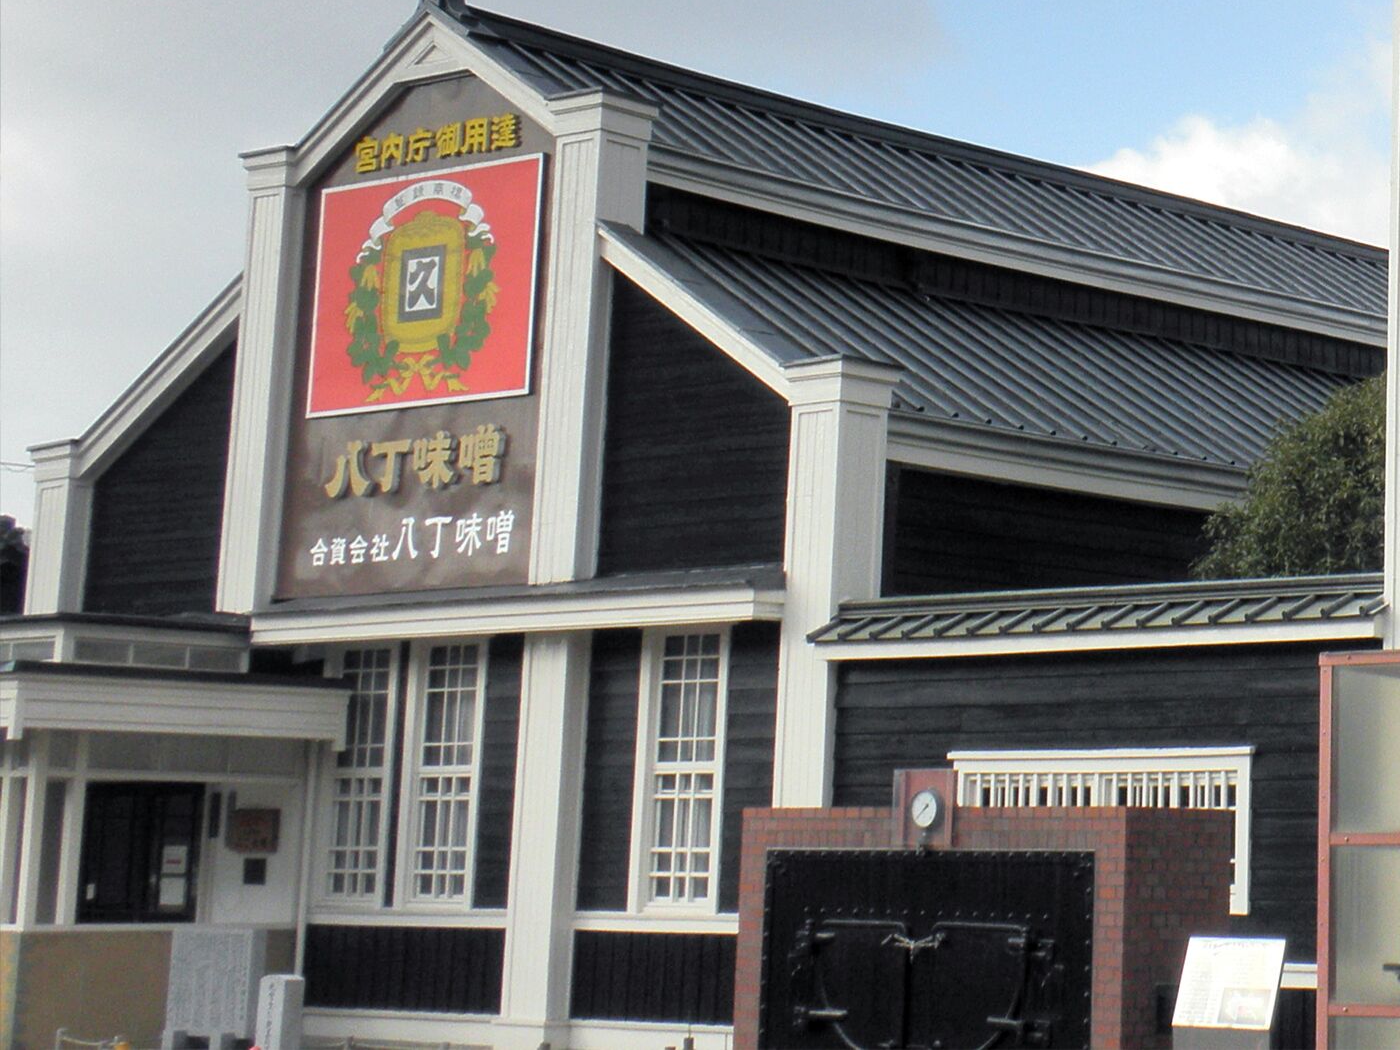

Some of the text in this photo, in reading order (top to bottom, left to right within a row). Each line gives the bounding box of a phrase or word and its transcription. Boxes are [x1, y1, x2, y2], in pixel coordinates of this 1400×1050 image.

[355, 113, 518, 173] 宮内庁御用達
[407, 258, 438, 310] 久
[324, 423, 502, 498] 八丁味噌
[310, 509, 516, 567] 合資会社八丁味噌
